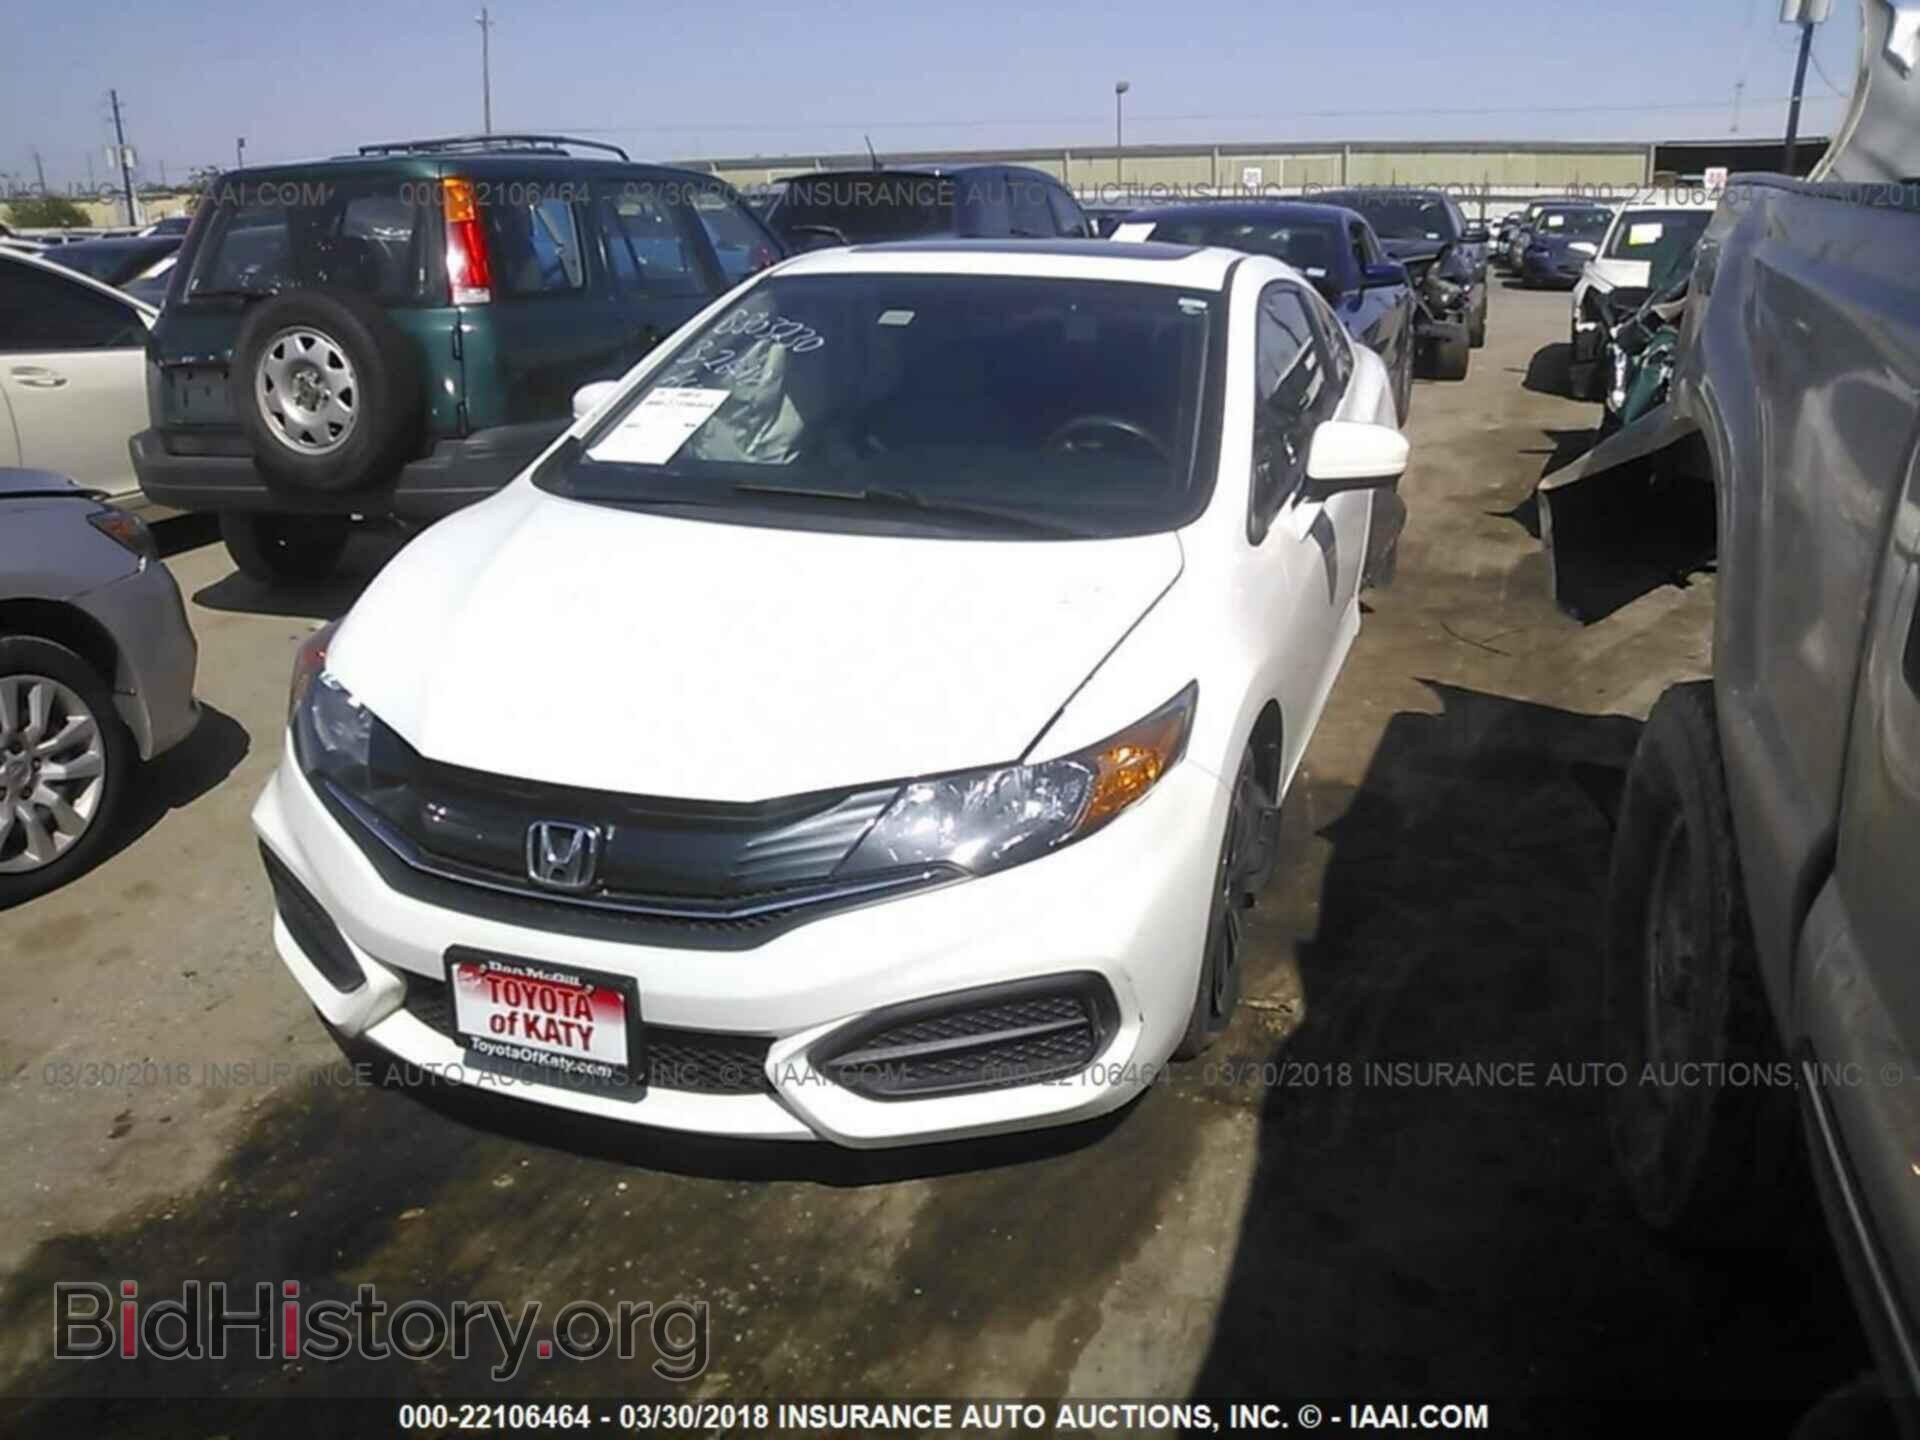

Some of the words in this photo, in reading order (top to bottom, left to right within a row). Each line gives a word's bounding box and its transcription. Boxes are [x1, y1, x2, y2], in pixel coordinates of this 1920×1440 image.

[486, 976, 594, 1022] TOYOTA
[489, 1010, 518, 1036] of
[522, 1013, 595, 1051] KATY
[471, 1036, 613, 1078] ToyotaOfKaty.com
